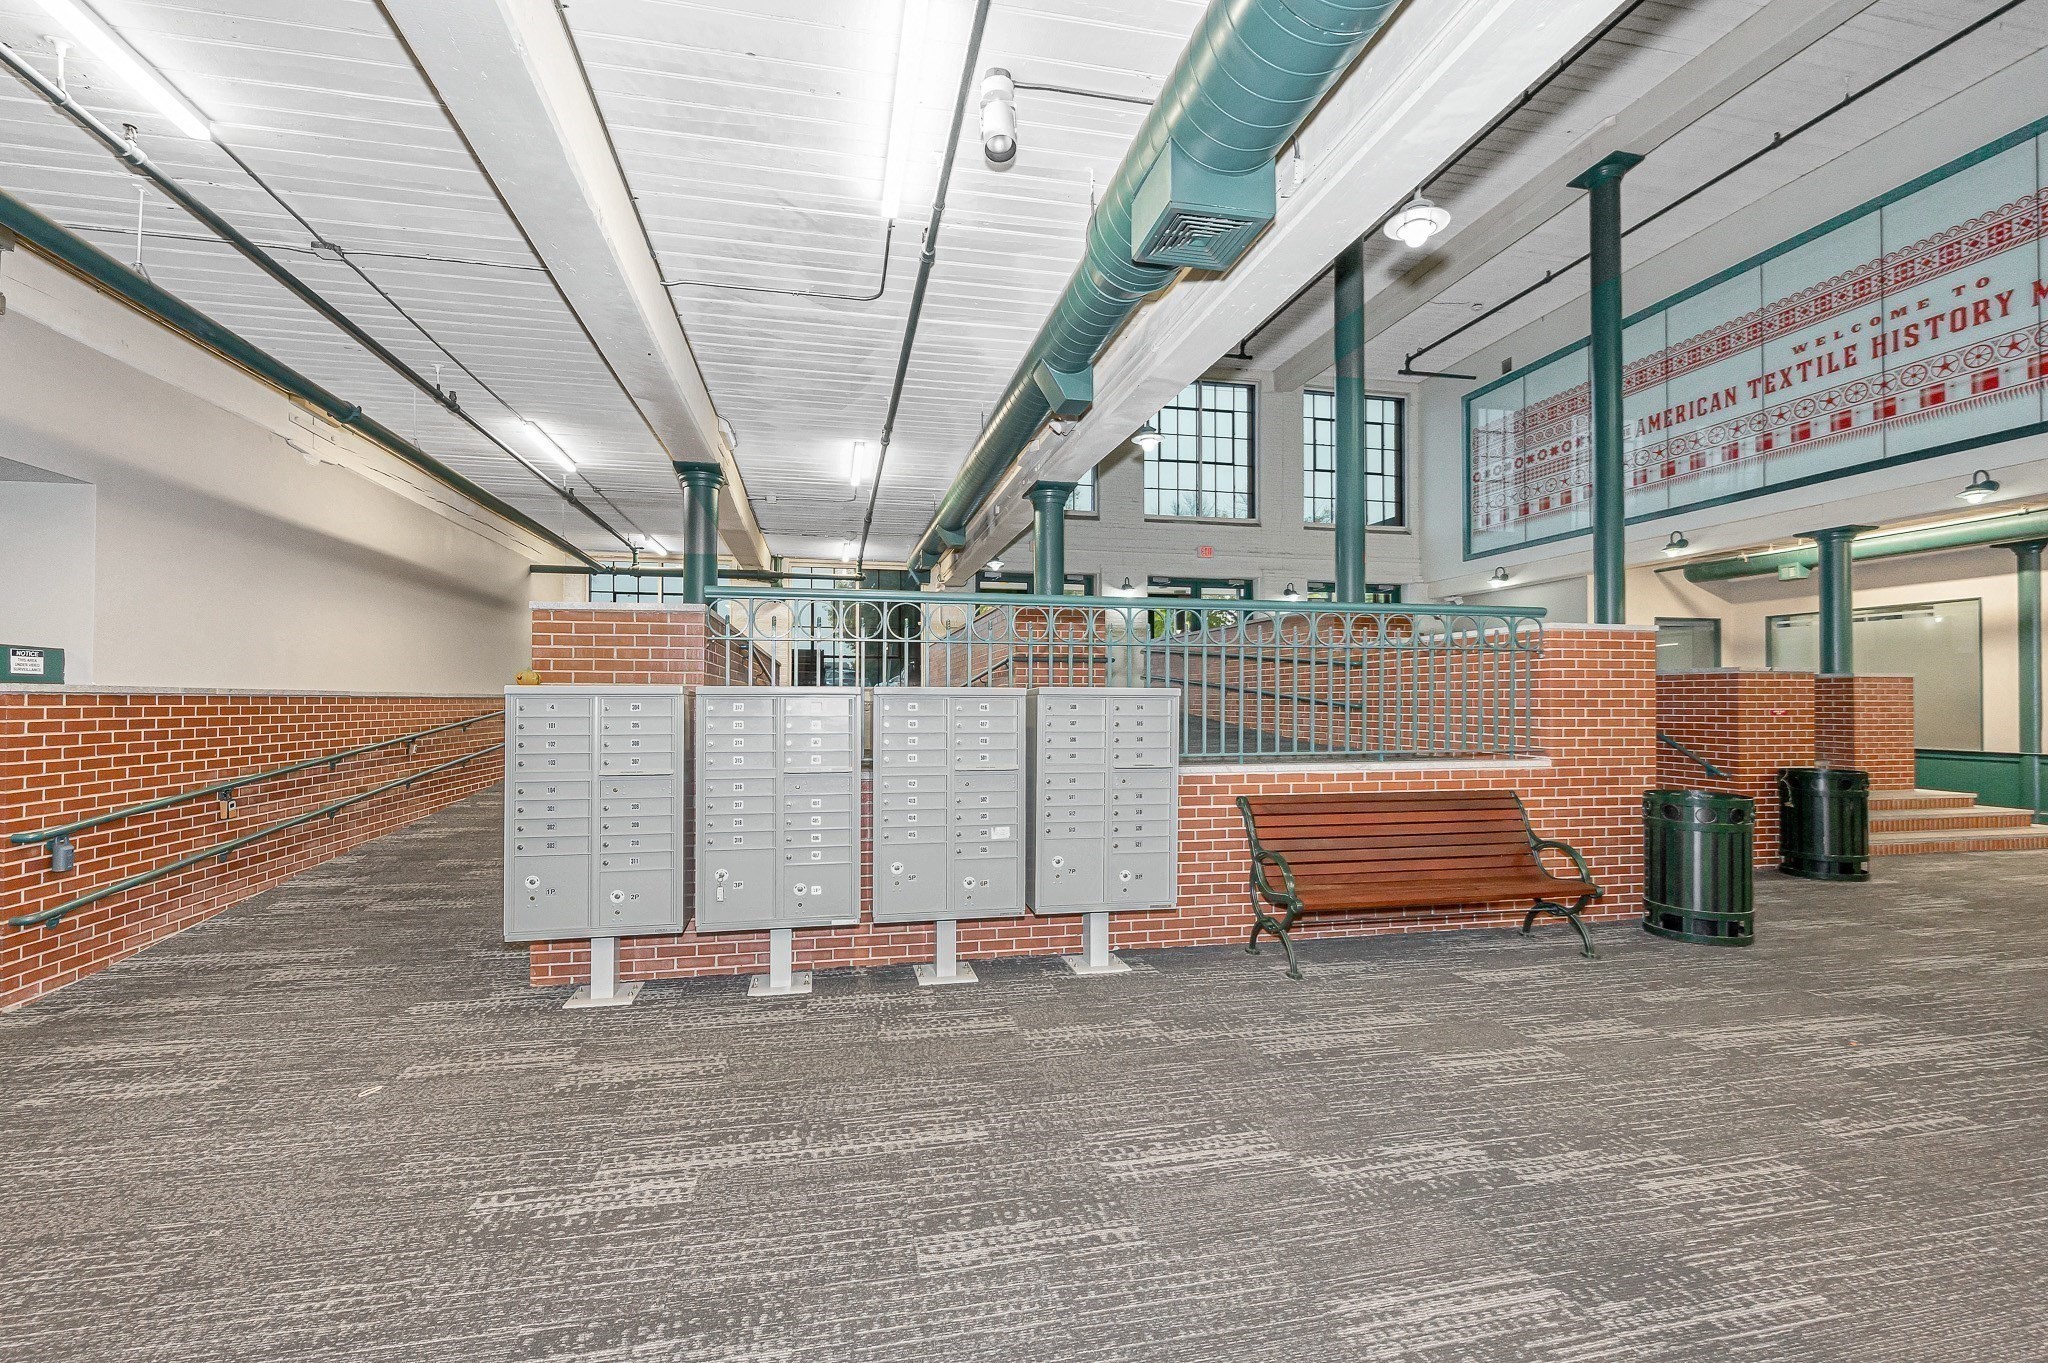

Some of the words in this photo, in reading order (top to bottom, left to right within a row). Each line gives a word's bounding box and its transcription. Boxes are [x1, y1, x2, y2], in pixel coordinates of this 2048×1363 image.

[1637, 386, 1738, 439] AMERICAN
[1747, 343, 1858, 399] TEXTILE
[1871, 289, 2014, 359] HISTORY
[1792, 298, 1930, 354] WELCOME
[1953, 276, 1991, 296] TO
